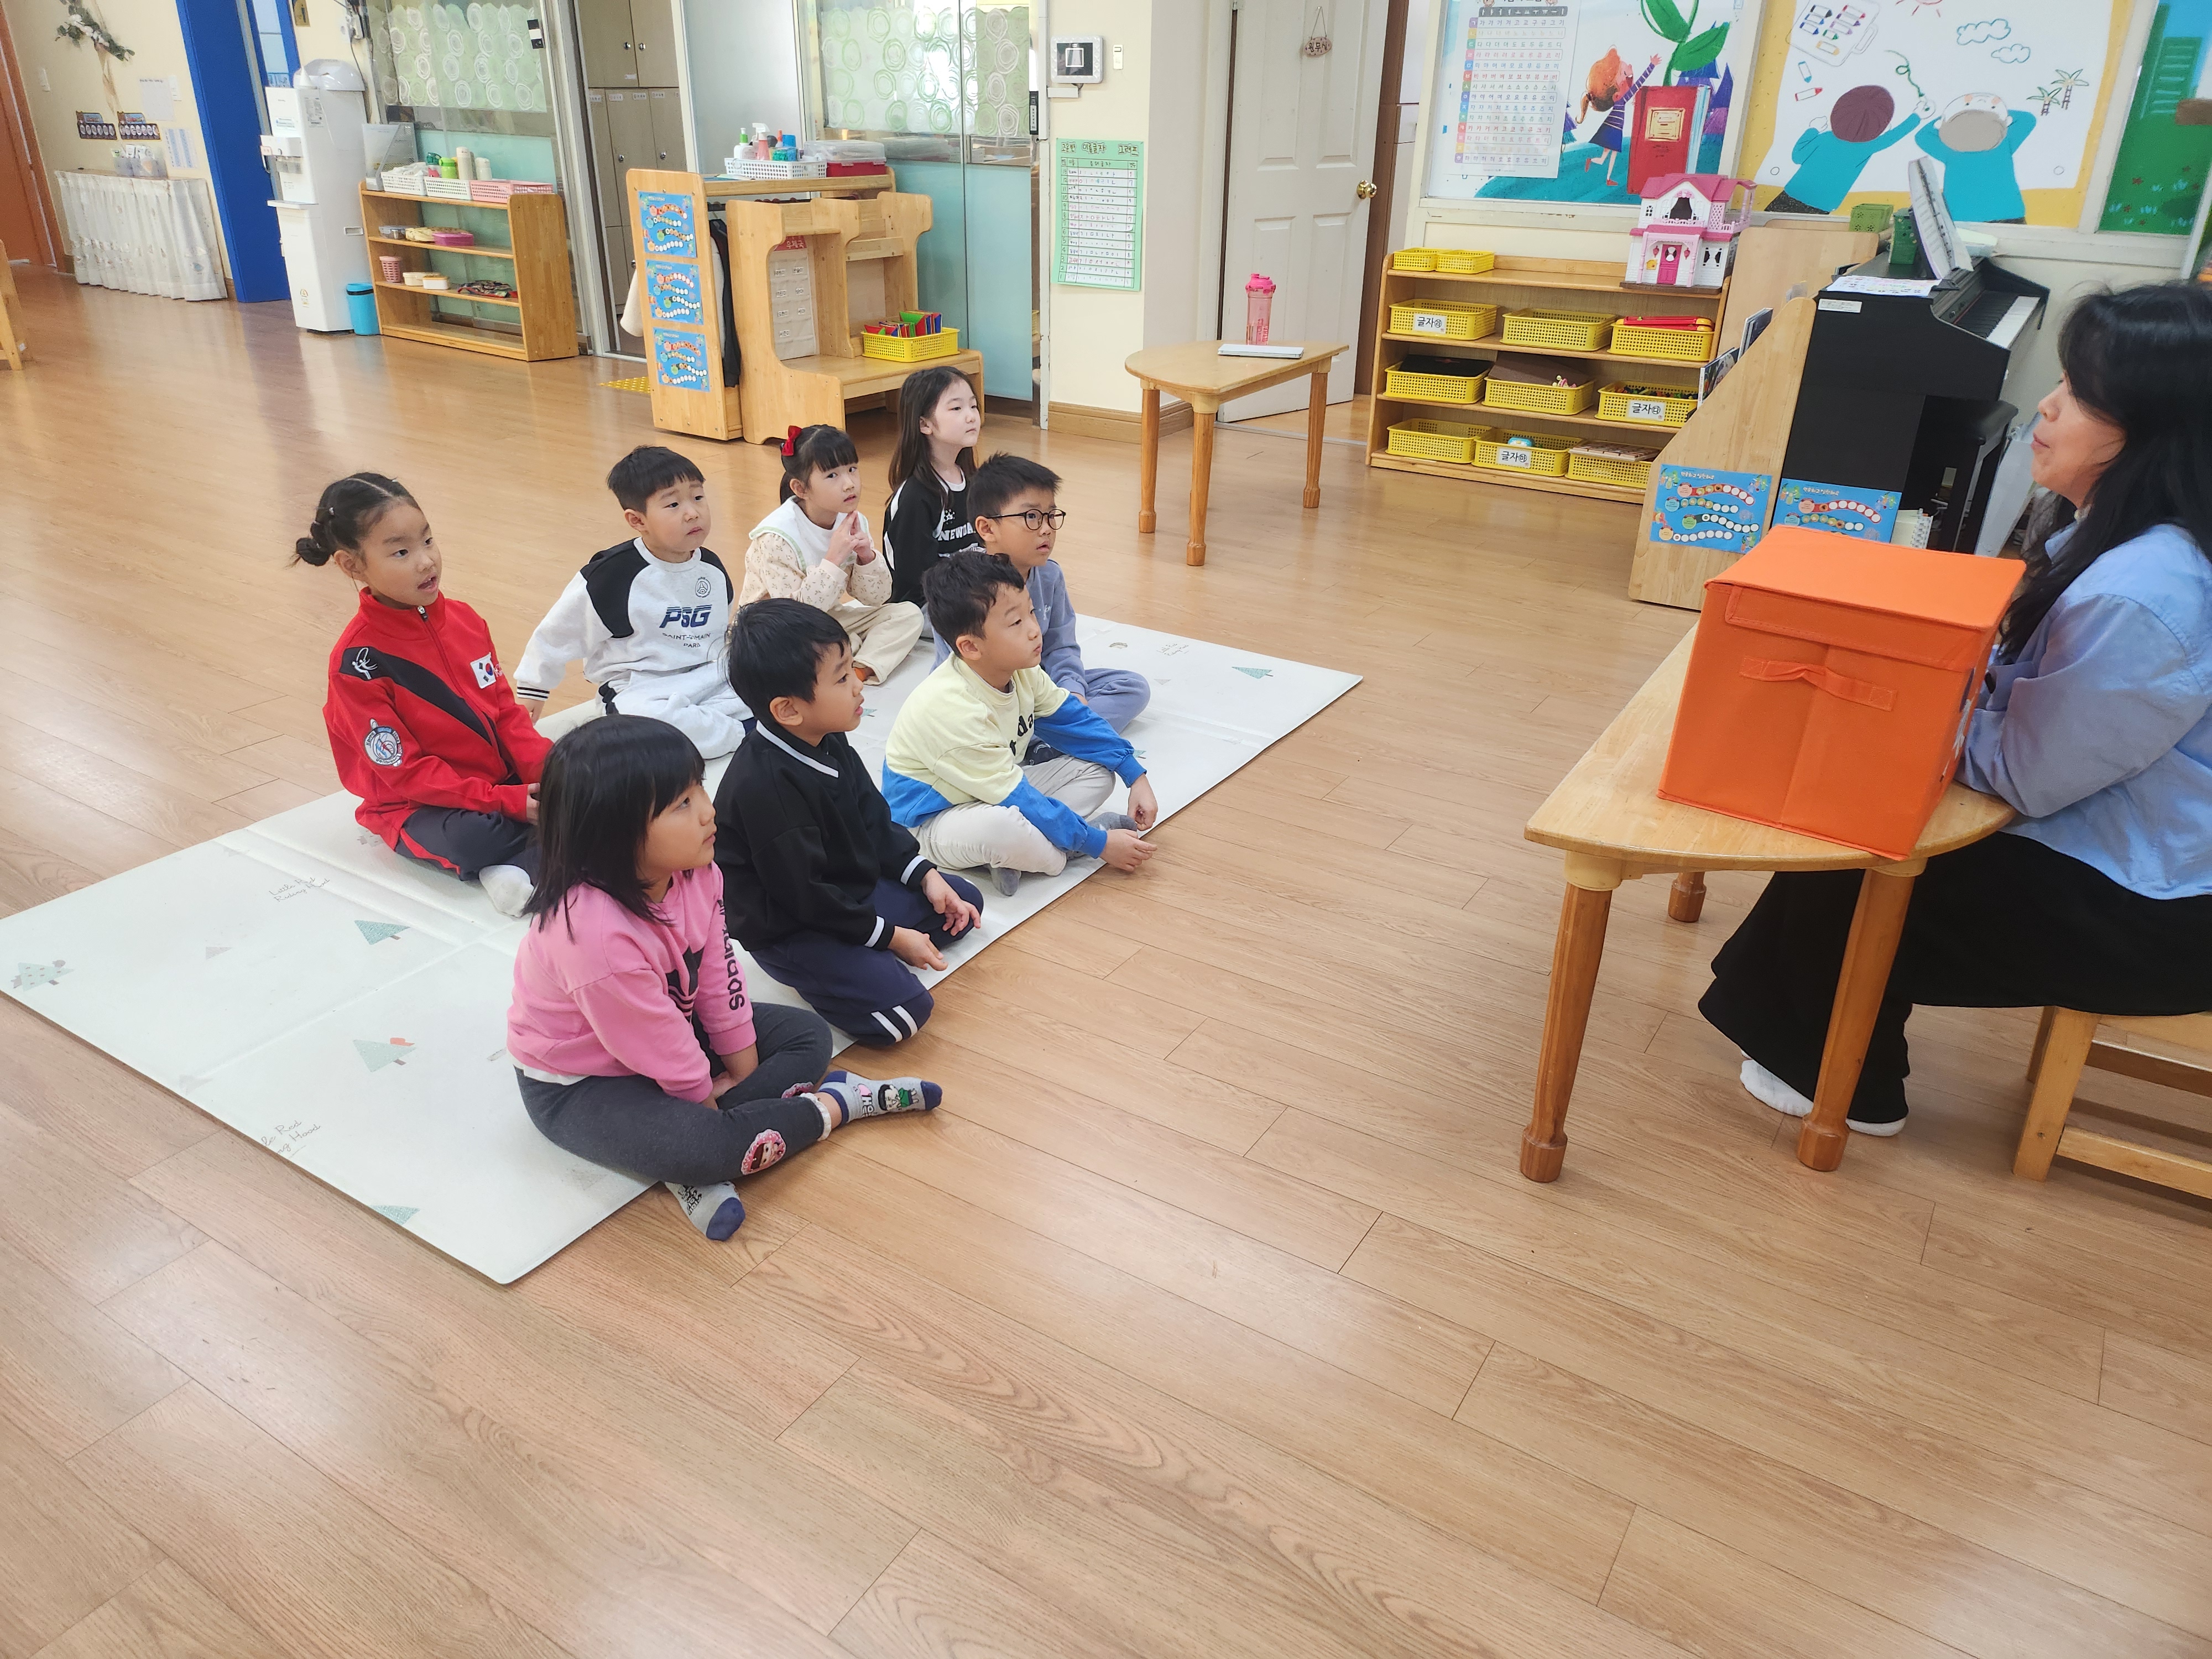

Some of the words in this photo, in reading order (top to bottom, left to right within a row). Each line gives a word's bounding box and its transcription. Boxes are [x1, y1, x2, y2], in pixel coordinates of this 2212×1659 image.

[1119, 144, 1139, 156] 그래프
[659, 604, 713, 629] PSG
[274, 1120, 302, 1135] Red
[289, 1124, 321, 1142] Hood
